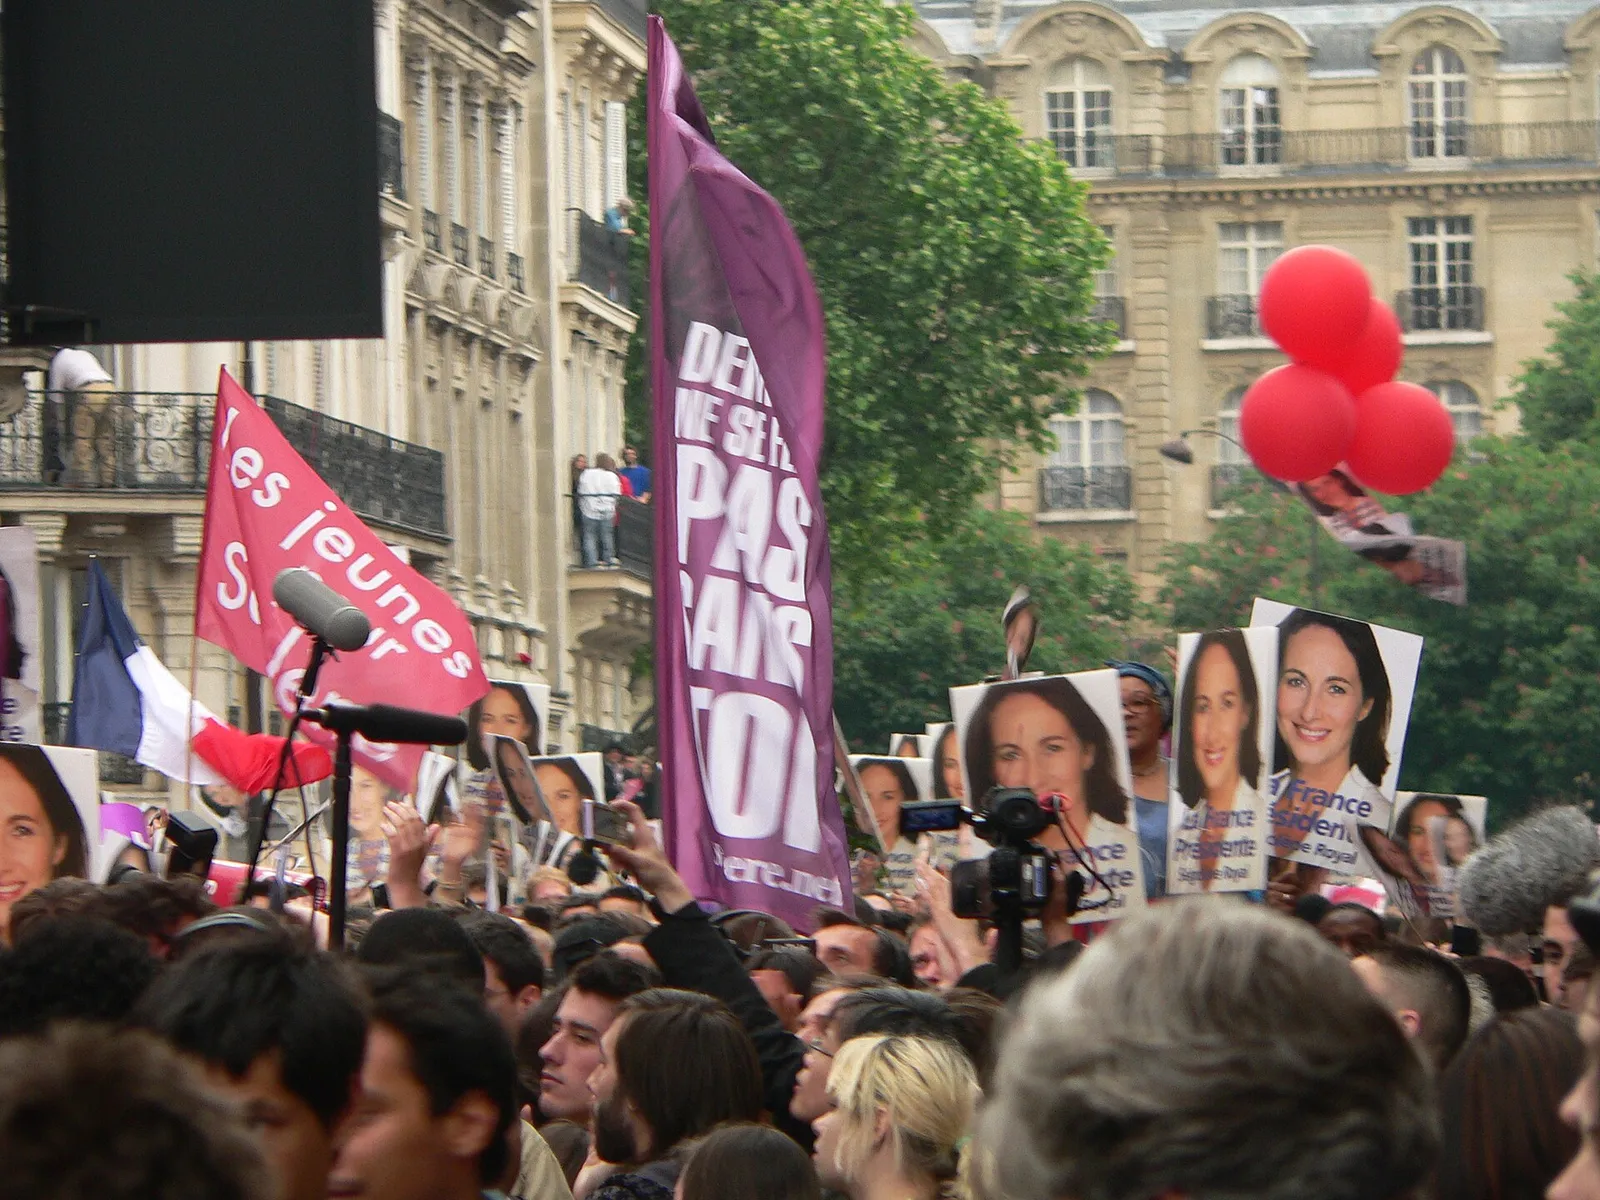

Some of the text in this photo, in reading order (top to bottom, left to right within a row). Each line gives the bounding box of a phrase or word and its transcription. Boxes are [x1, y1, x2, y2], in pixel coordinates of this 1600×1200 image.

[279, 500, 473, 679] jeunes
[676, 443, 813, 602] PAS
[689, 685, 821, 853] TOI
[1288, 779, 1373, 818] France
